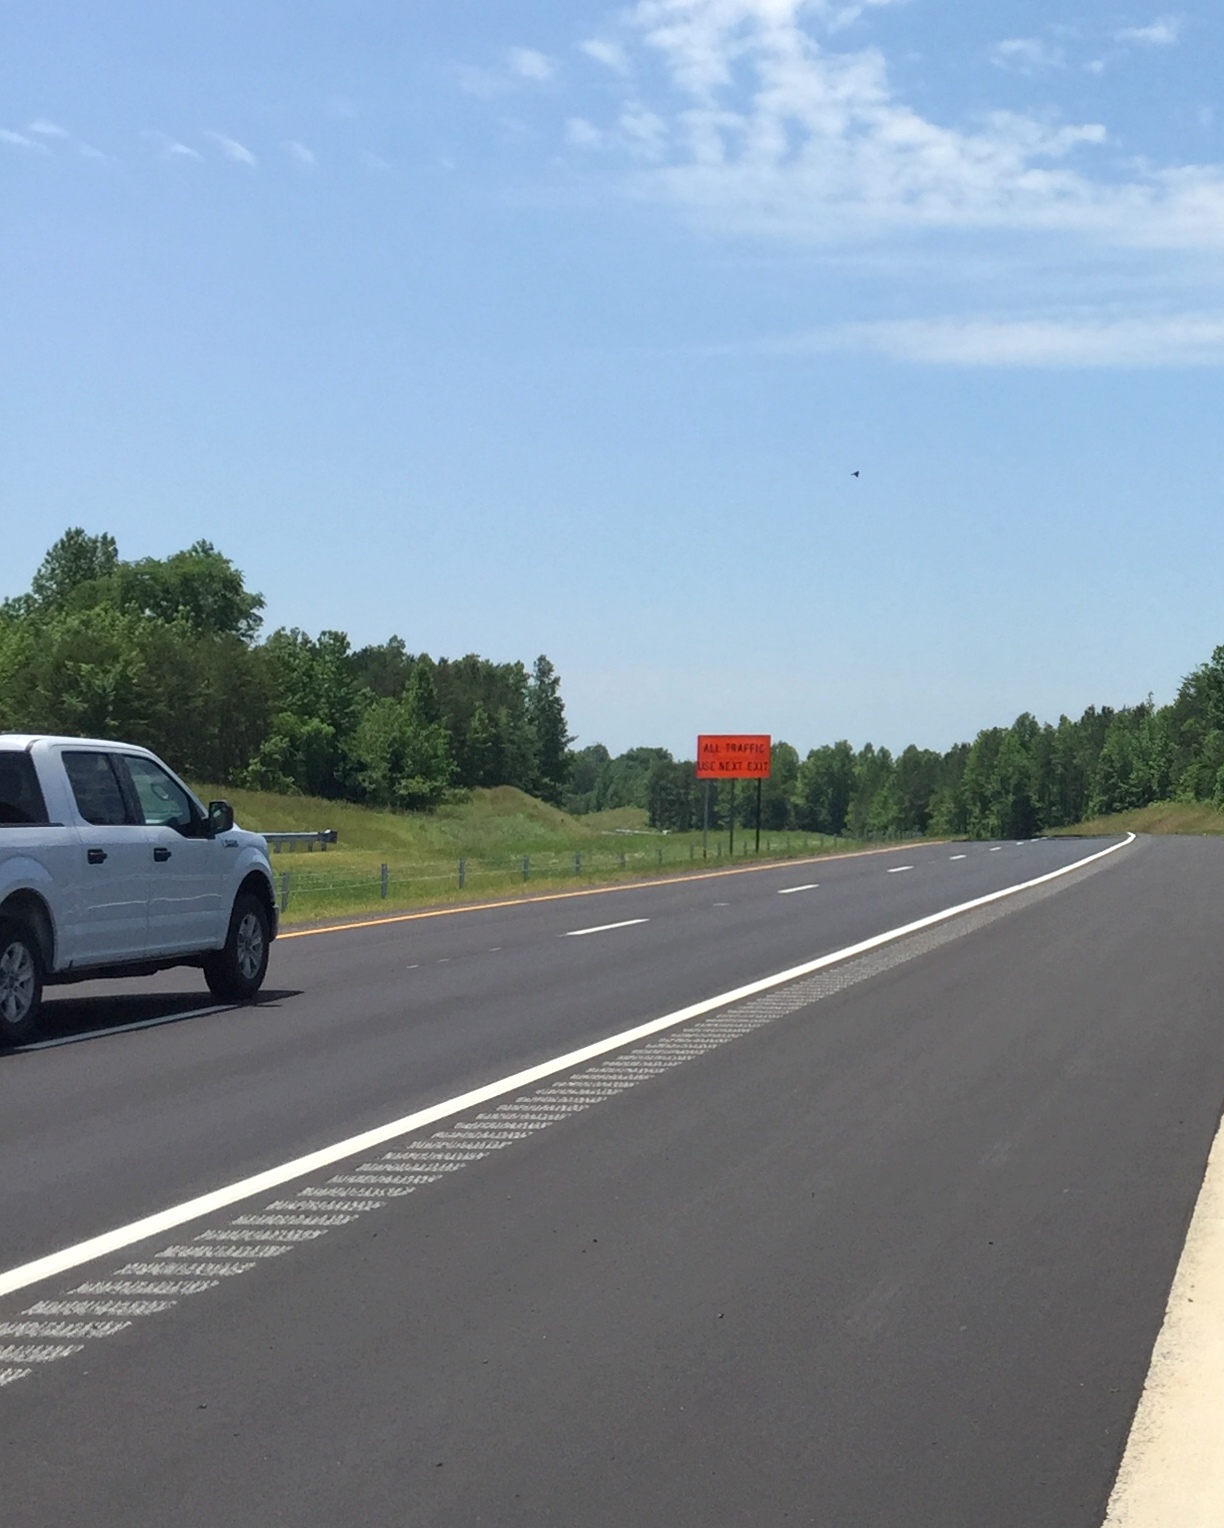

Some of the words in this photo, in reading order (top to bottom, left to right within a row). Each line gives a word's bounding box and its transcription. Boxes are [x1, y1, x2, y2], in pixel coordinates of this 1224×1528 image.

[704, 743, 721, 753] ALL
[726, 743, 765, 753] TRAFFIC
[698, 761, 715, 771] USE
[720, 761, 742, 771] NEXT
[747, 761, 768, 771] EXIT
